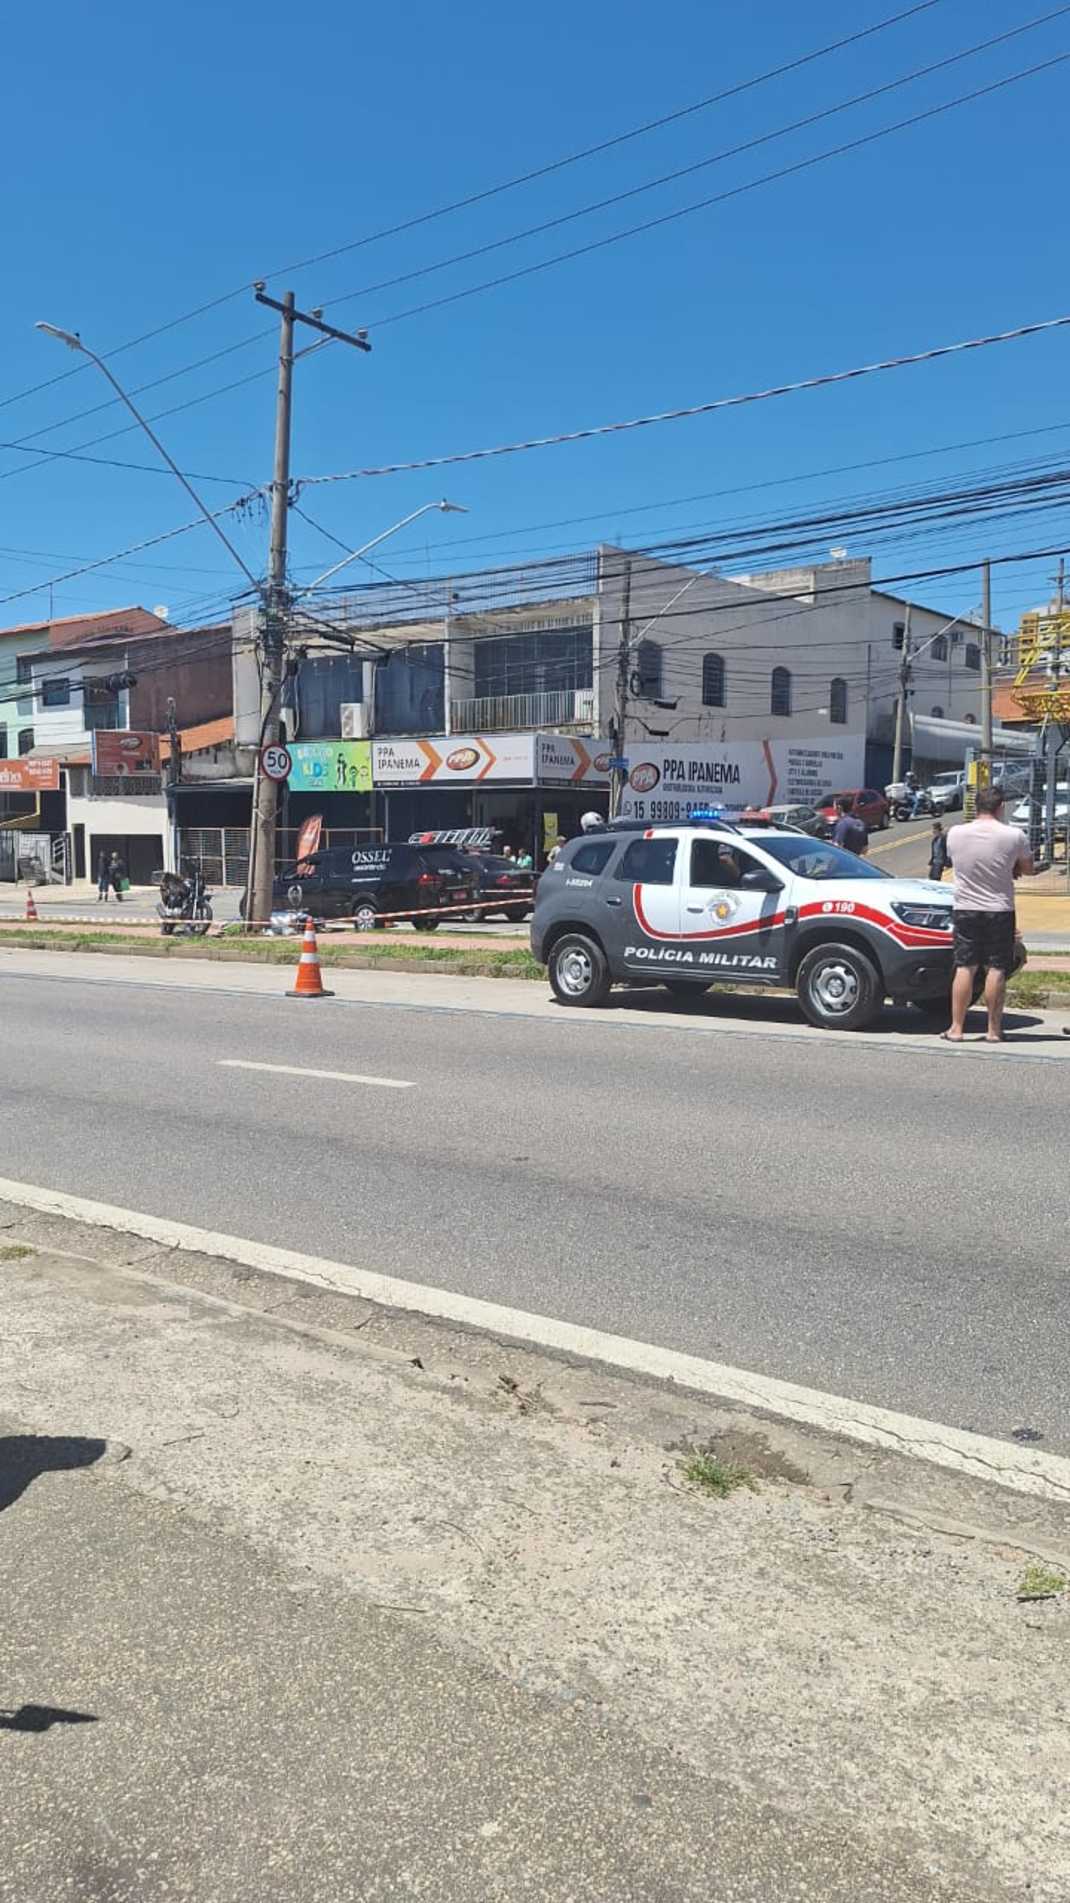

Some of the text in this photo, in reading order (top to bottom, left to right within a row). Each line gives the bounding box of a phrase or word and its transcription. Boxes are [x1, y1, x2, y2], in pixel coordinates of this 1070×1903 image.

[266, 751, 288, 770] 50
[377, 747, 395, 757] PPA
[377, 758, 421, 770] IPANEMA
[662, 758, 741, 785] PPA IPANEMA
[633, 801, 645, 820] 15
[351, 850, 390, 865] OSSEL
[835, 902, 856, 914] 190
[624, 946, 778, 969] POLÍCIA MILITAR
